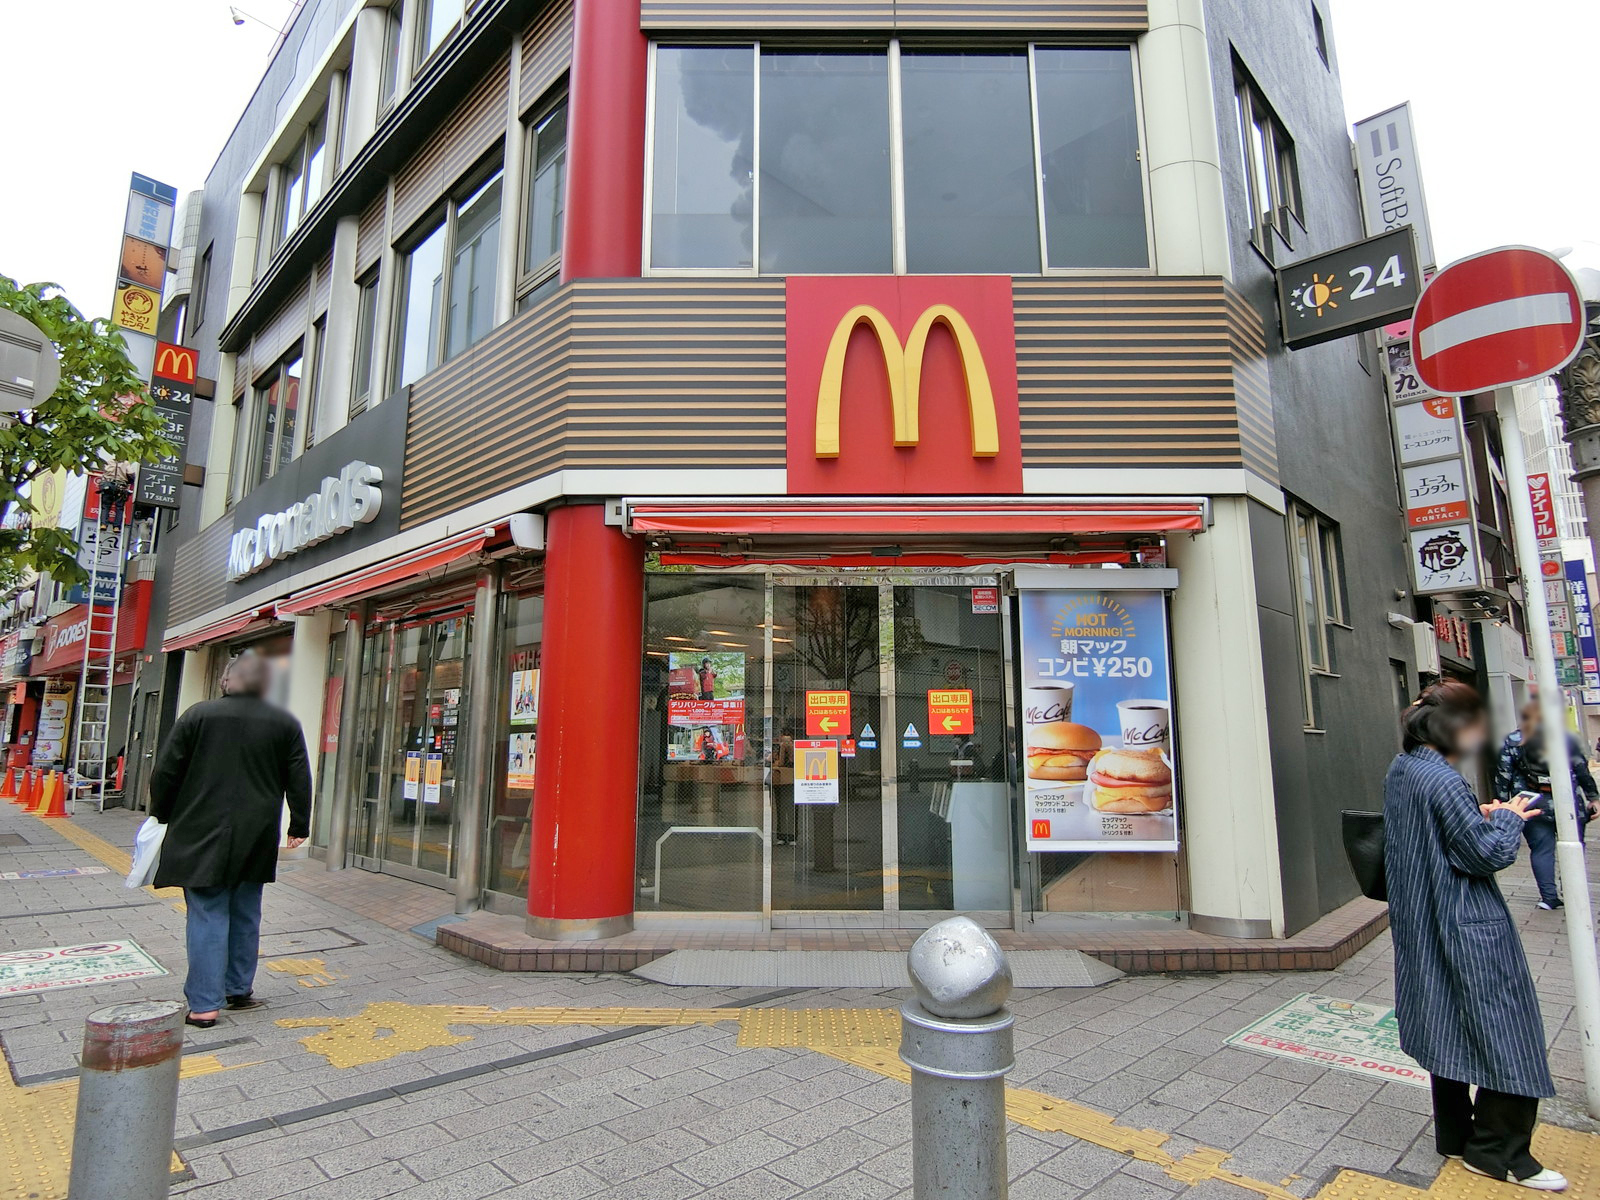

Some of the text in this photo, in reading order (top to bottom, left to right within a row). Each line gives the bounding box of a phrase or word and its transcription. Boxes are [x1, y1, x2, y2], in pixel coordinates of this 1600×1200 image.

[1349, 255, 1405, 301] 24
[120, 310, 150, 324] やきとり
[120, 318, 151, 331] センター
[1394, 373, 1419, 394] 九
[172, 390, 192, 405] 24
[1434, 406, 1449, 416] 1F
[168, 422, 184, 434] 3F
[166, 433, 185, 442] SEATS
[1404, 435, 1453, 450] エースコンタクト
[159, 463, 178, 472] SEATS
[1419, 475, 1447, 488] エース
[160, 484, 176, 495] 1F
[1410, 482, 1459, 498] コンタクト
[144, 491, 175, 503] 17 SEATS
[1427, 506, 1447, 515] ACE
[1531, 487, 1553, 537] アイフル
[1415, 511, 1461, 523] CONTACT
[1539, 540, 1554, 548] 3F
[1422, 571, 1472, 587] グラム
[1570, 580, 1592, 638] 洋服の青山
[1076, 614, 1108, 626] HOT
[57, 620, 88, 648] ADORES
[1064, 628, 1123, 637] MORNING!
[1060, 639, 1127, 654] 朝マック
[809, 694, 845, 705] 出口専用
[932, 693, 968, 704] 出口専用
